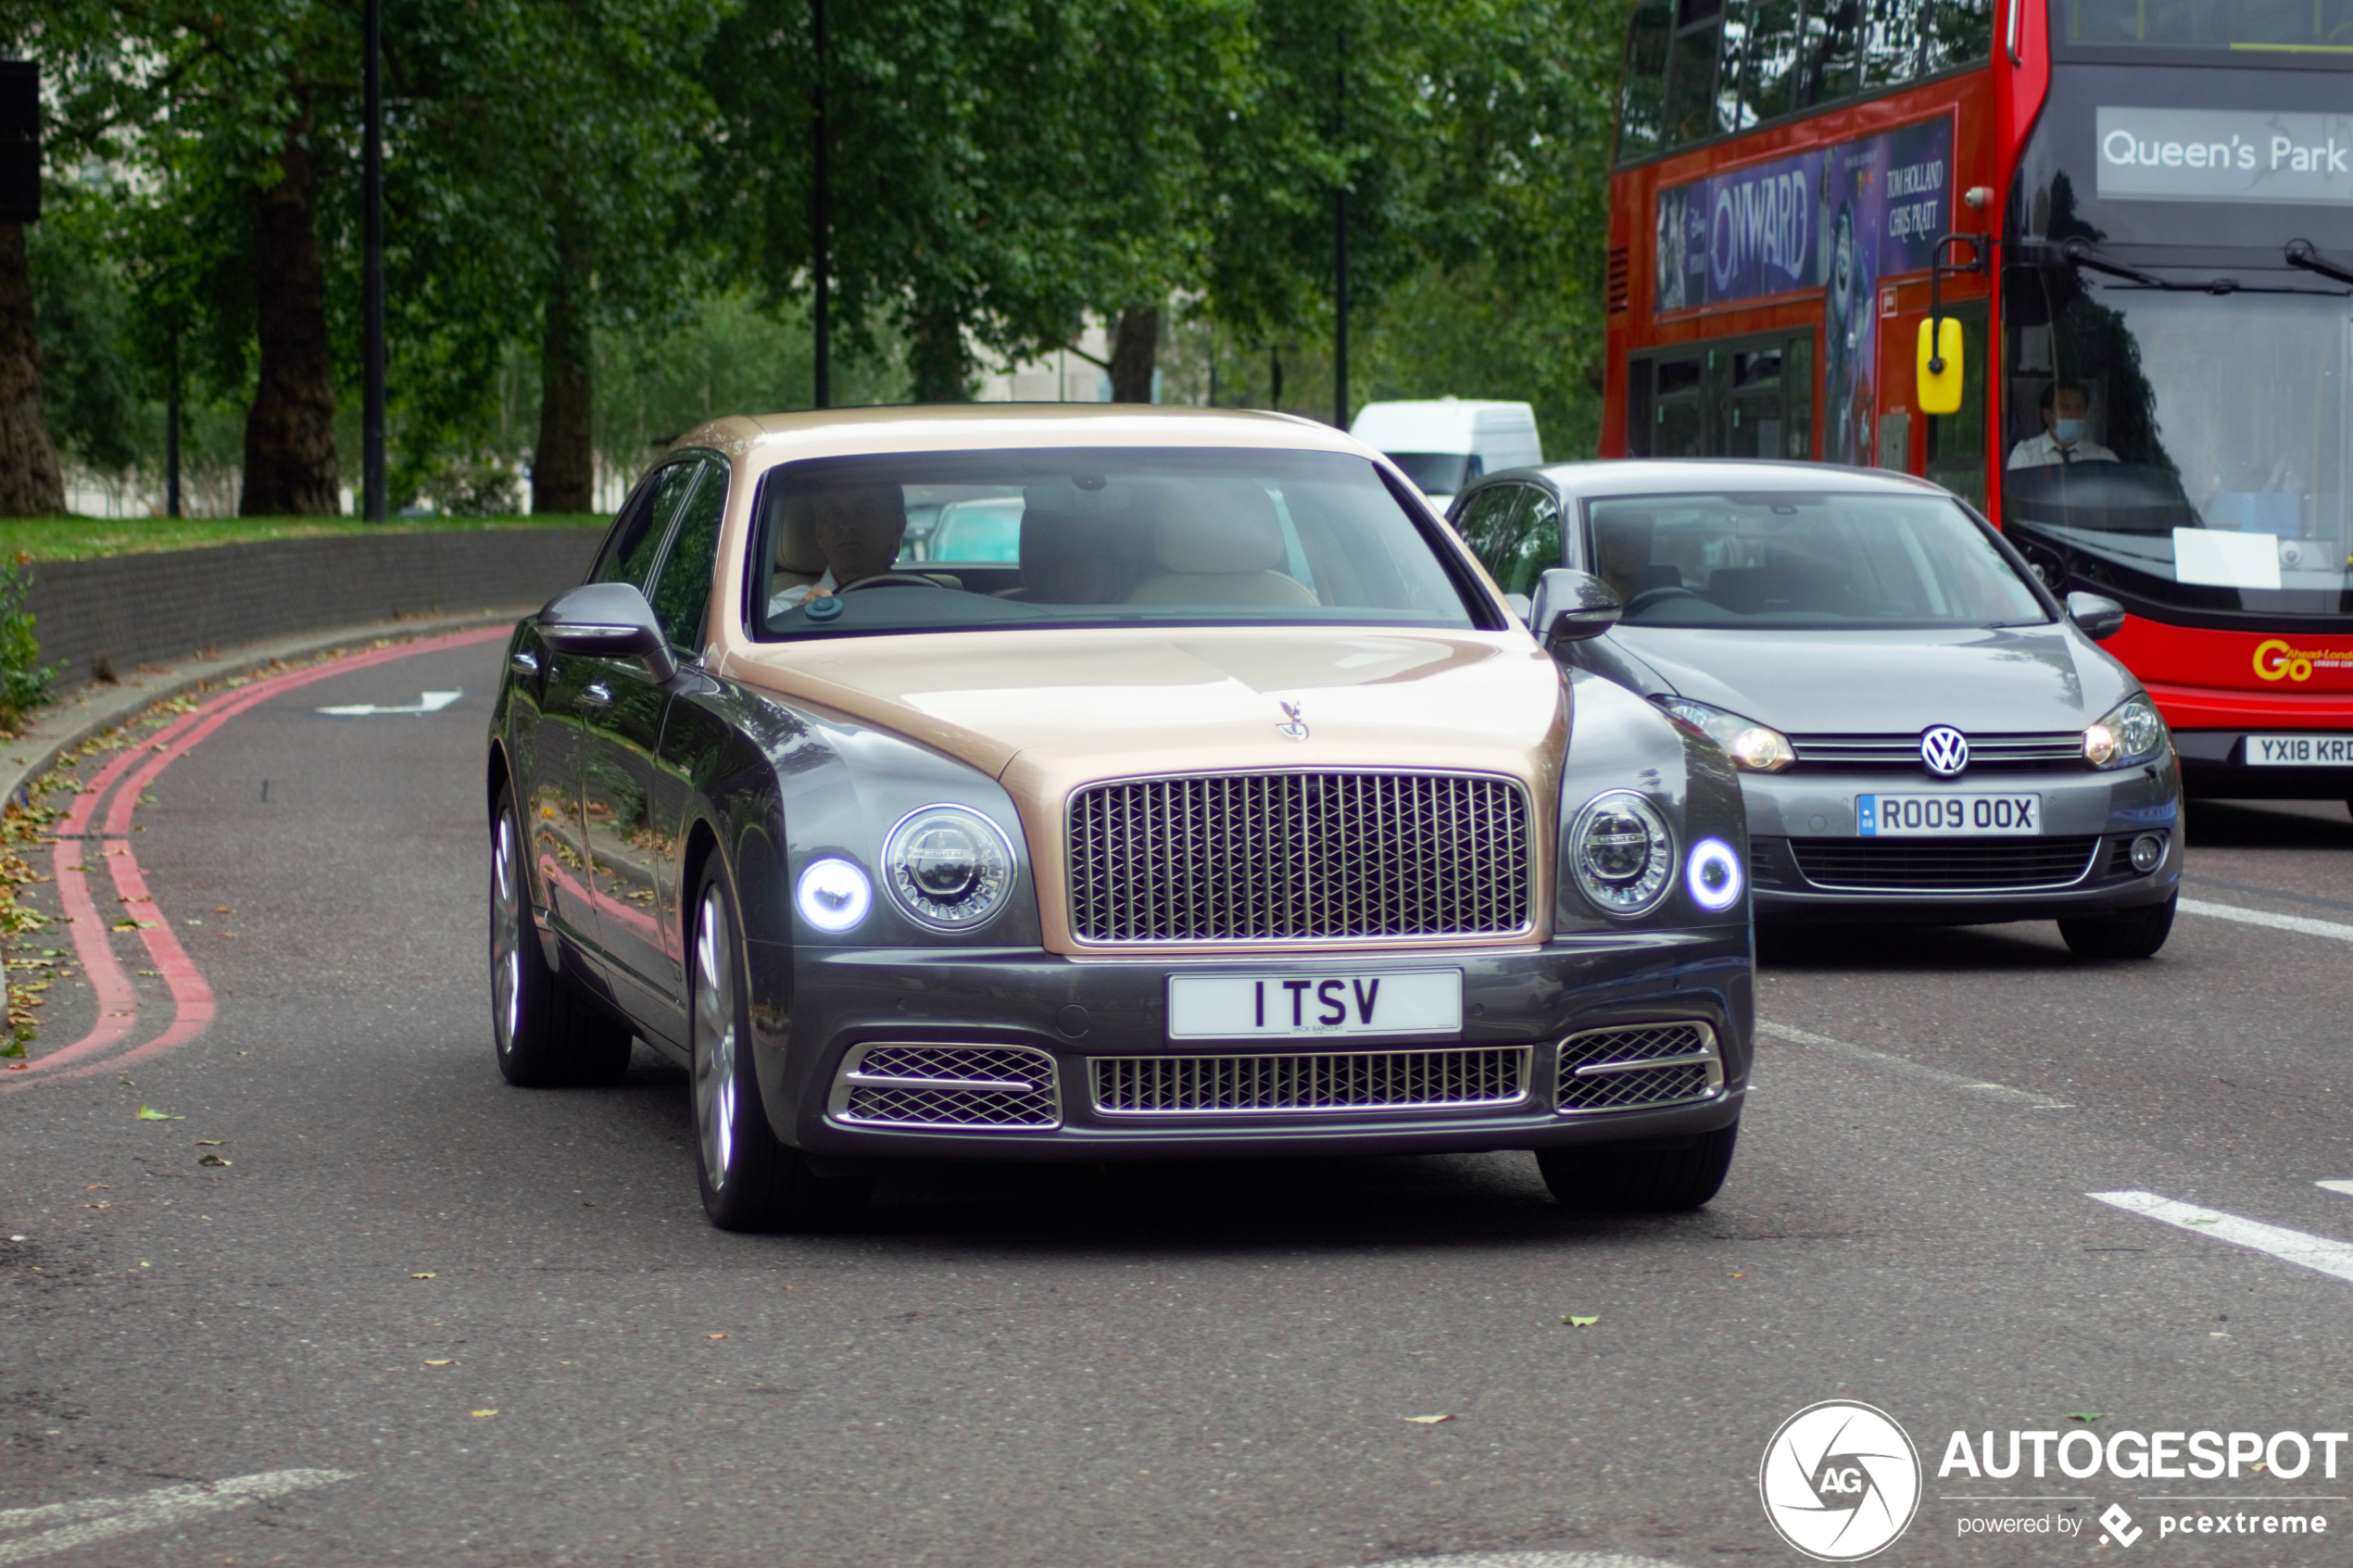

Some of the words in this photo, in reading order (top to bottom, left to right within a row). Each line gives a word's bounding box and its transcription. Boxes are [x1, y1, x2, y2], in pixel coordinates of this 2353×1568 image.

[2271, 135, 2348, 172] Park
[1887, 169, 1903, 199] TOM
[1904, 159, 1944, 195] HOLLAND
[1711, 169, 1807, 292] ONWARD
[1889, 205, 1910, 245] CHRIS
[1911, 200, 1938, 241] PRATT
[2253, 639, 2312, 682] Go
[2261, 740, 2309, 760] YX18
[1862, 819, 1874, 827] GB
